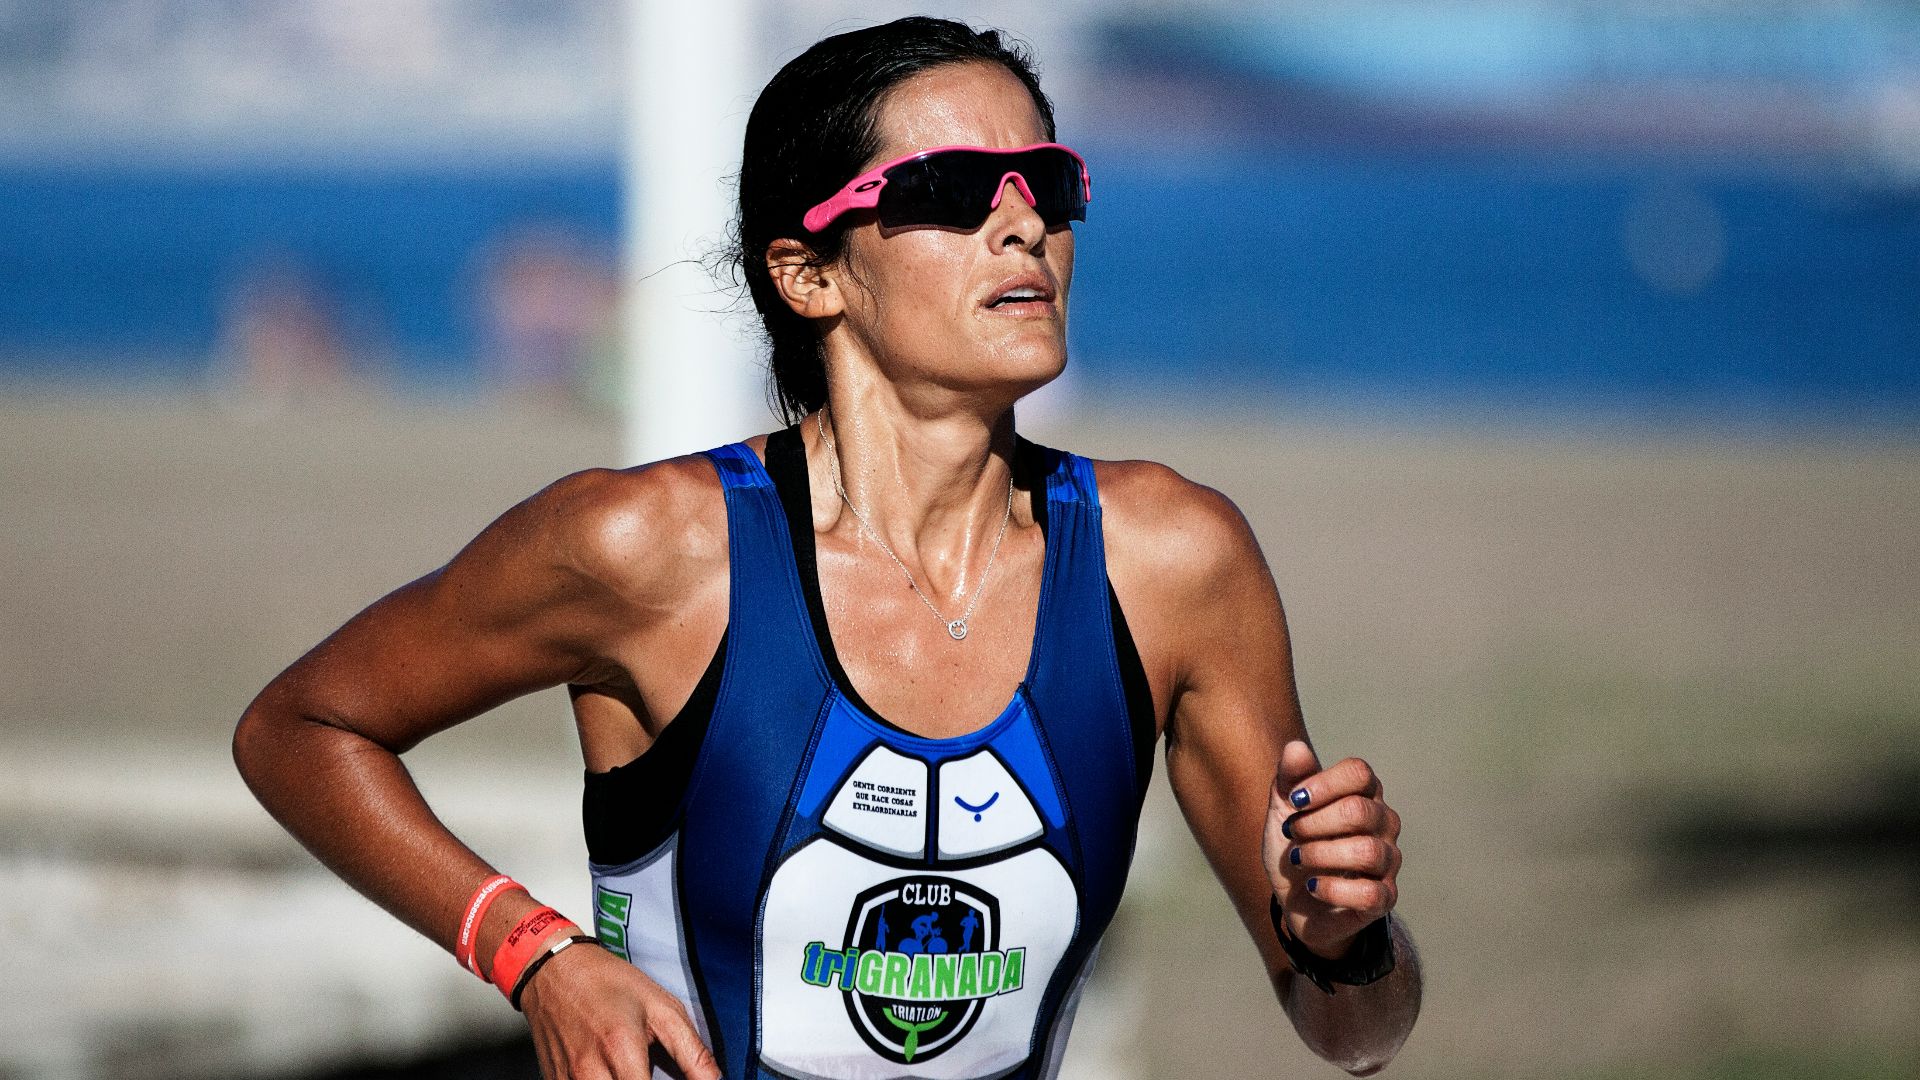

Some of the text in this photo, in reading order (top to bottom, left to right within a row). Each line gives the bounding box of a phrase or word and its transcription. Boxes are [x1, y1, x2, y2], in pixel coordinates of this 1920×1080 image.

[853, 780, 916, 797] GENTE CORRIENTE
[855, 791, 914, 807] QUE HACE COSAS
[852, 802, 918, 818] EXTRAORDINARIAS
[902, 883, 951, 906] CLUB
